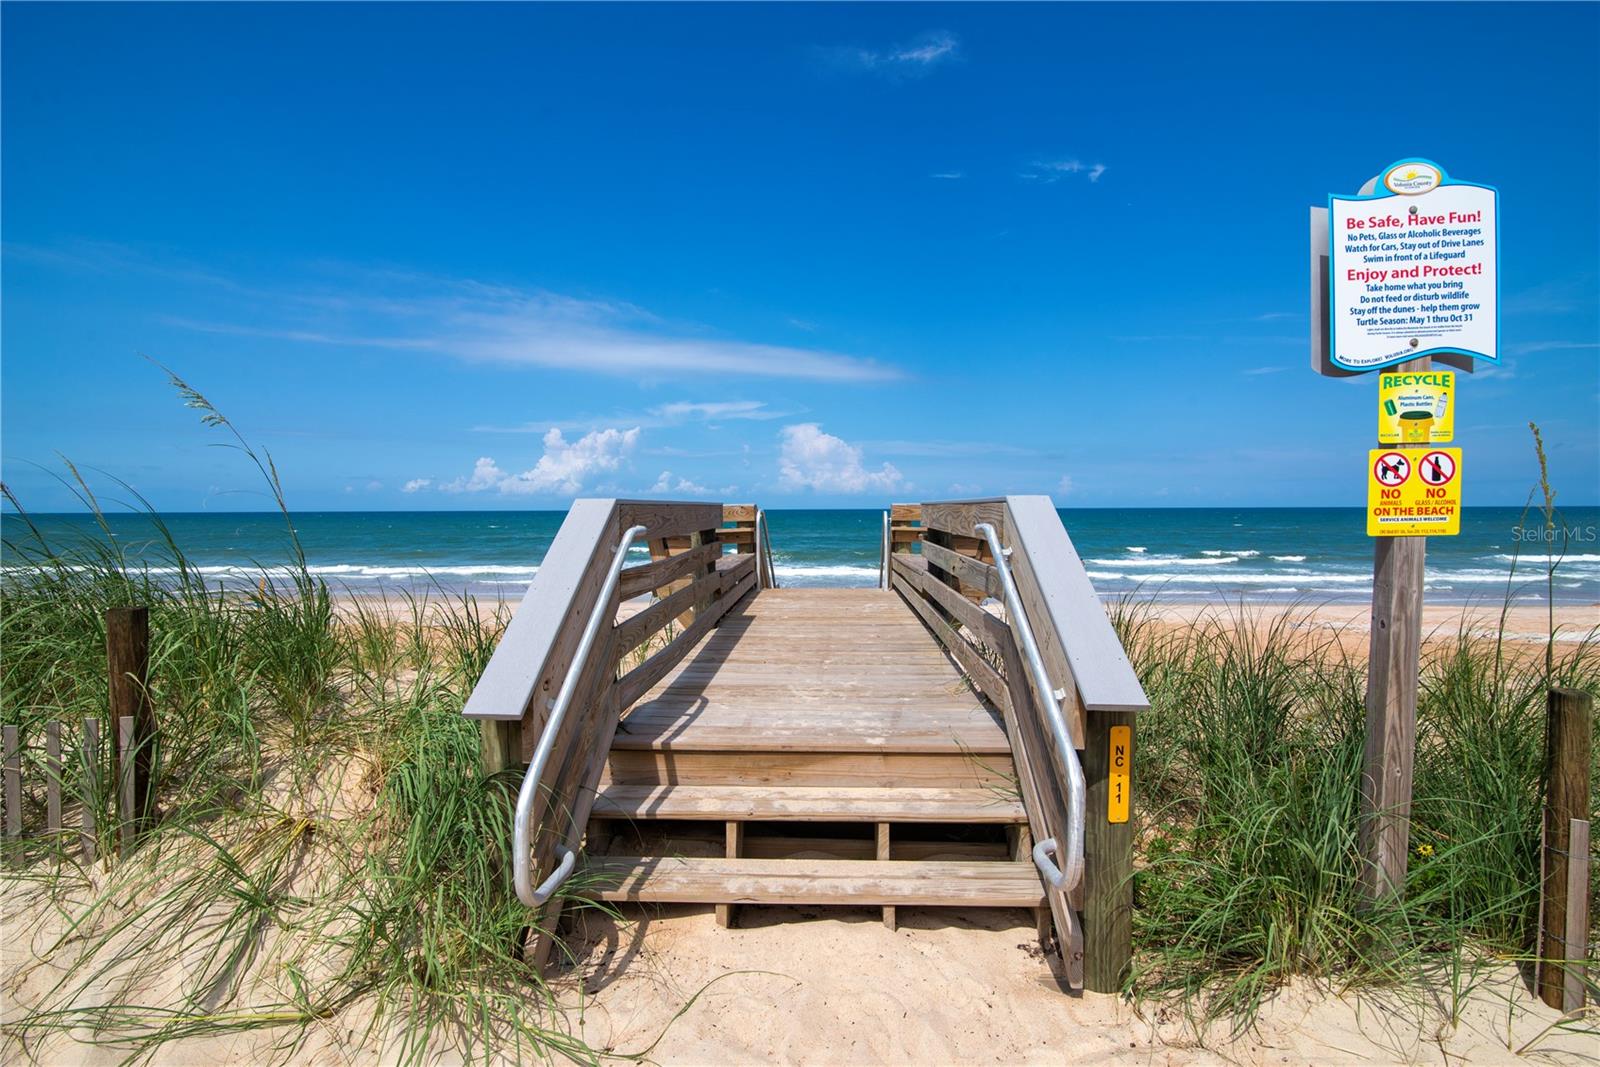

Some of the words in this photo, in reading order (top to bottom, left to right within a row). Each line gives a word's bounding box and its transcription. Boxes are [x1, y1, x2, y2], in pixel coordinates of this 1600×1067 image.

[1347, 218, 1365, 229] Be
[1369, 215, 1404, 228] Safe,
[1408, 214, 1445, 226] Have
[1449, 210, 1481, 223] Fun!
[1359, 233, 1377, 241] Pets,
[1378, 232, 1398, 240] Glass
[1408, 229, 1441, 238] Alcoholic
[1442, 228, 1481, 237] Beverages
[1345, 244, 1368, 253] Watch
[1381, 243, 1399, 251] Cars,
[1400, 242, 1416, 251] Stay
[1432, 240, 1440, 248] of
[1441, 239, 1461, 248] Drive
[1462, 239, 1484, 247] Lanes
[1363, 254, 1384, 263] Swim
[1385, 254, 1393, 262] in
[1394, 253, 1412, 261] front
[1414, 252, 1422, 261] of
[1430, 250, 1465, 261] Lifeguard
[1347, 268, 1388, 283] Enjoy
[1391, 266, 1419, 279] and
[1423, 263, 1482, 277] Protect!
[1366, 284, 1383, 292] Take
[1384, 283, 1406, 291] home
[1407, 282, 1426, 290] what
[1428, 283, 1441, 291] you
[1443, 280, 1463, 290] bring
[1360, 295, 1370, 303] Do
[1385, 294, 1402, 302] feed
[1412, 292, 1440, 301] disturb
[1441, 291, 1469, 300] wildlife
[1350, 307, 1366, 316] Stay
[1367, 306, 1378, 314] off
[1379, 306, 1391, 314] the
[1392, 305, 1415, 313] dunes
[1420, 303, 1438, 314] help
[1438, 303, 1459, 311] them
[1460, 303, 1480, 312] grow
[1356, 318, 1378, 326] Turtle
[1379, 317, 1408, 325] Season:
[1409, 316, 1425, 325] May
[1432, 315, 1449, 323] thru
[1450, 314, 1463, 322] Oct
[1383, 374, 1451, 389] RECYCLE
[1380, 489, 1401, 499] NO
[1426, 488, 1447, 498] NO
[1373, 507, 1391, 516] ON
[1392, 507, 1414, 516] THE
[1417, 506, 1454, 515] BEACH
